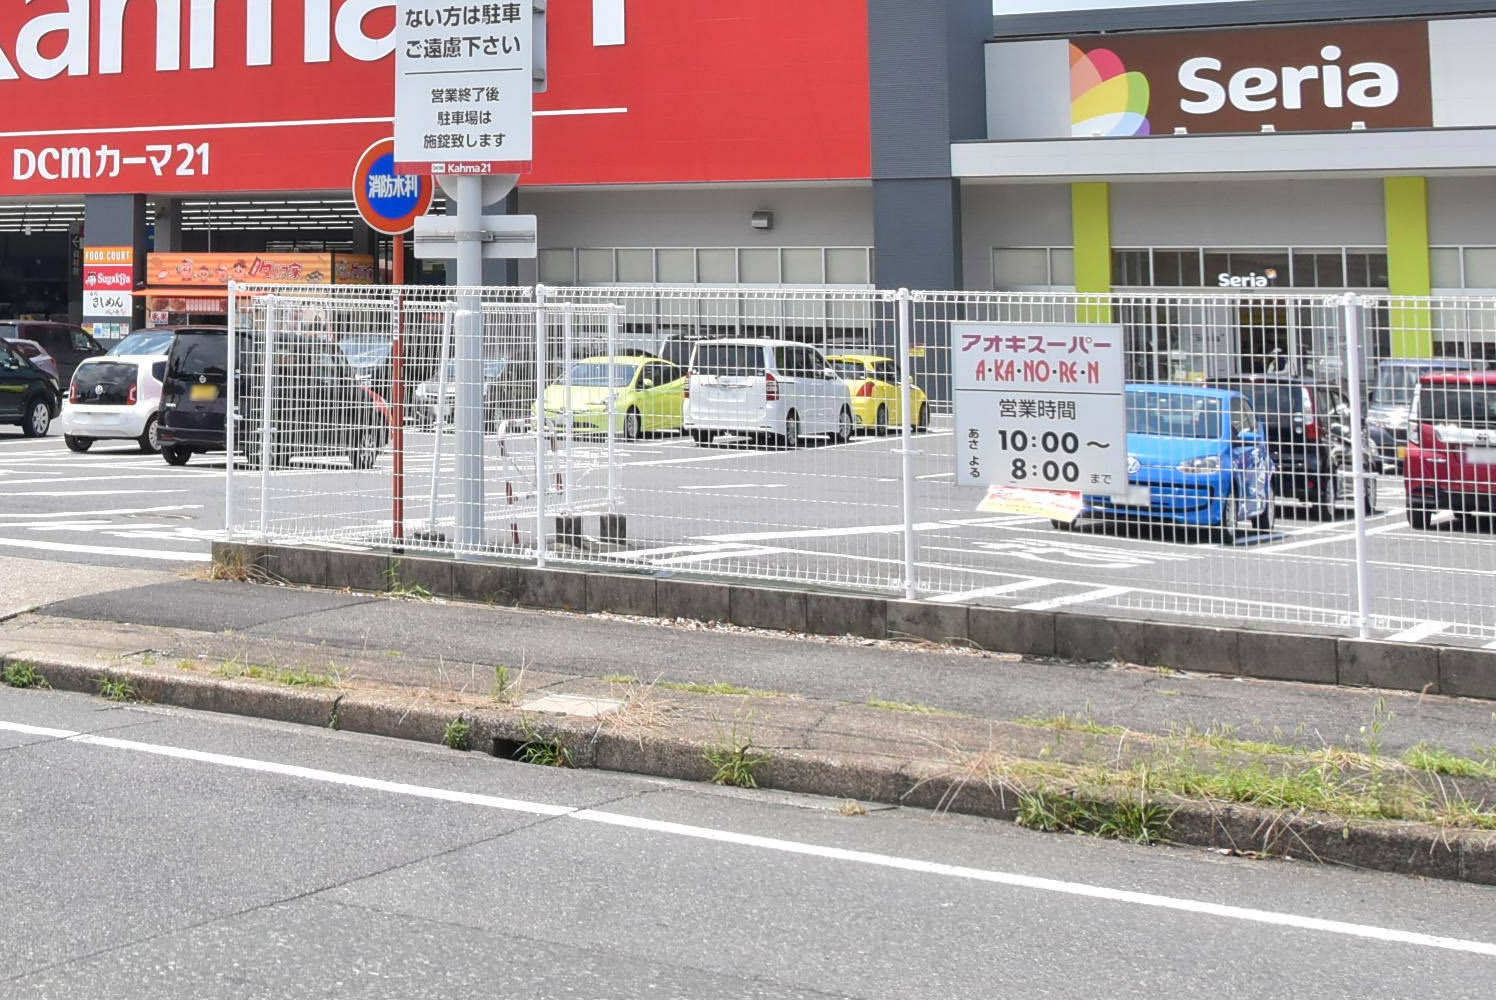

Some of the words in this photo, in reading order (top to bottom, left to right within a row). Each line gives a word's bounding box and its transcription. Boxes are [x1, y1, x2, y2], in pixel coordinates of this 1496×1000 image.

[405, 3, 522, 29] ない方は駐車
[405, 34, 521, 60] ご遠慮下さい
[1177, 45, 1399, 115] Seria
[431, 87, 500, 104] 営業終了後
[437, 110, 492, 126] 駐車場は
[423, 132, 506, 150] 施錠致します
[448, 163, 491, 173] Kahma21
[368, 174, 419, 199] 消防水利
[85, 251, 104, 261] FOOD
[106, 251, 130, 260] COURT
[1218, 272, 1268, 287] Seria
[962, 334, 1112, 354] アオキスーパー
[999, 398, 1076, 420] 営業時間
[968, 428, 980, 450] あさ
[969, 455, 981, 478] よる
[1011, 457, 1080, 483] 8:00
[1090, 473, 1112, 485] まで
